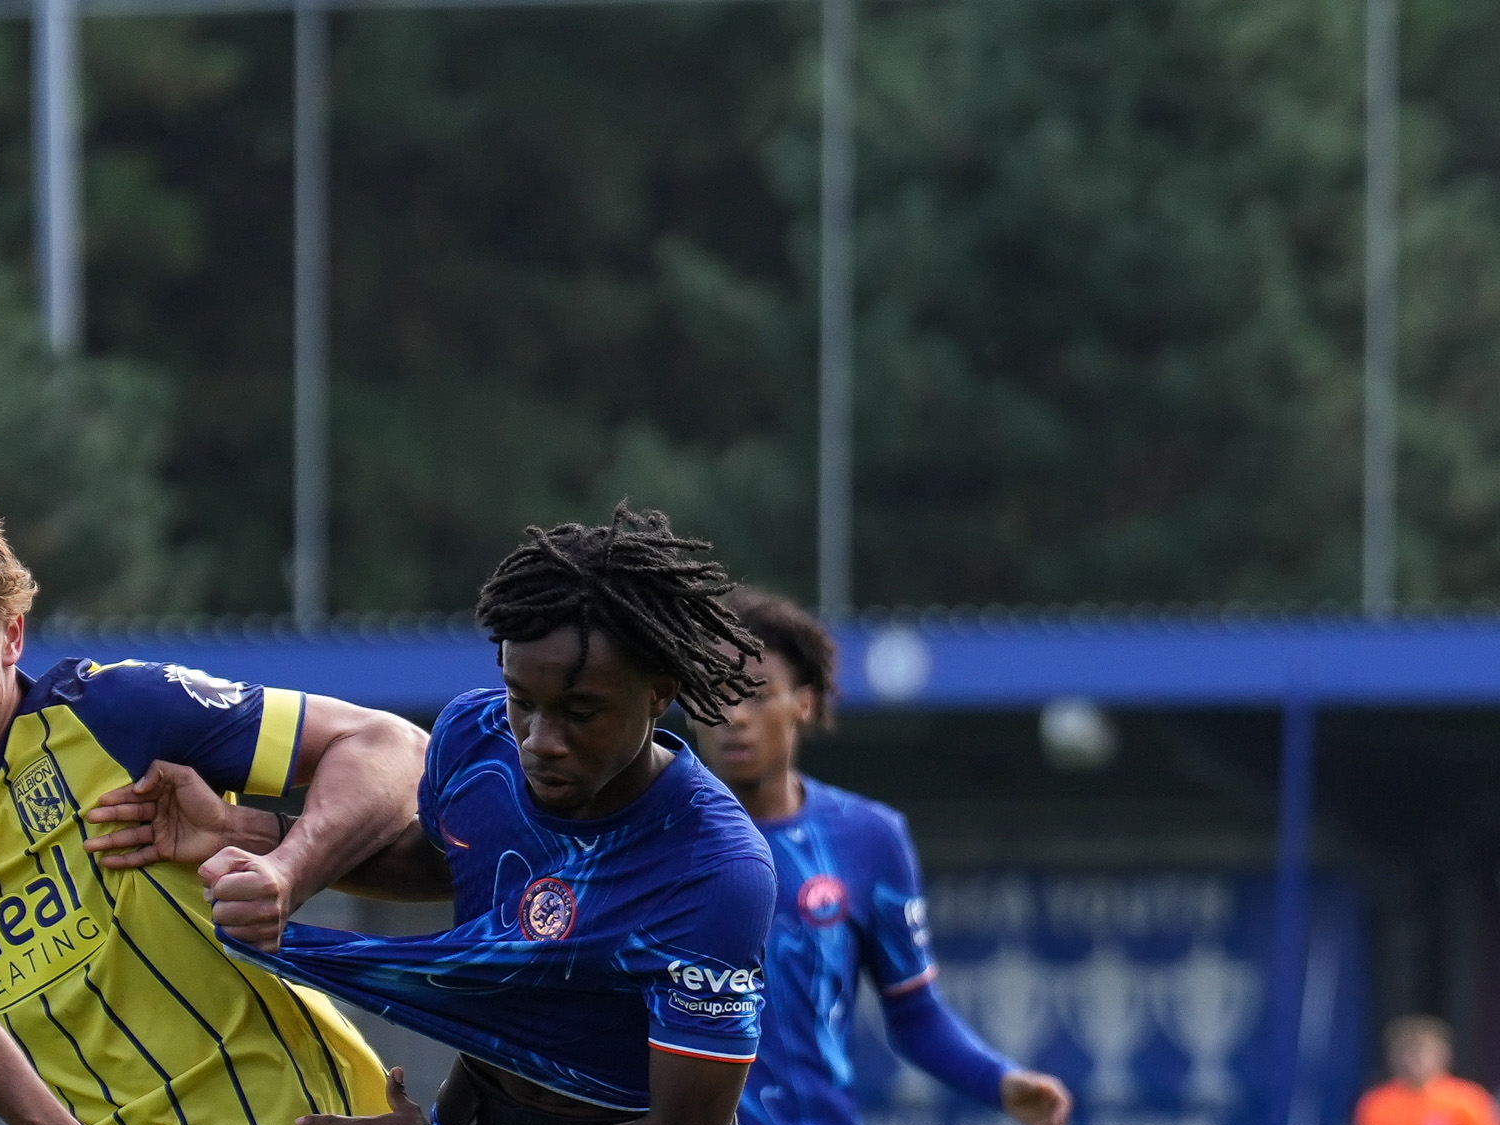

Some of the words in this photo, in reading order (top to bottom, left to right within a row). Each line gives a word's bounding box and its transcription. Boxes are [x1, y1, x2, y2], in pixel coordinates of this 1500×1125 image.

[17, 765, 52, 798] ALBION
[547, 882, 572, 916] CHELSEA
[666, 959, 762, 993] fever
